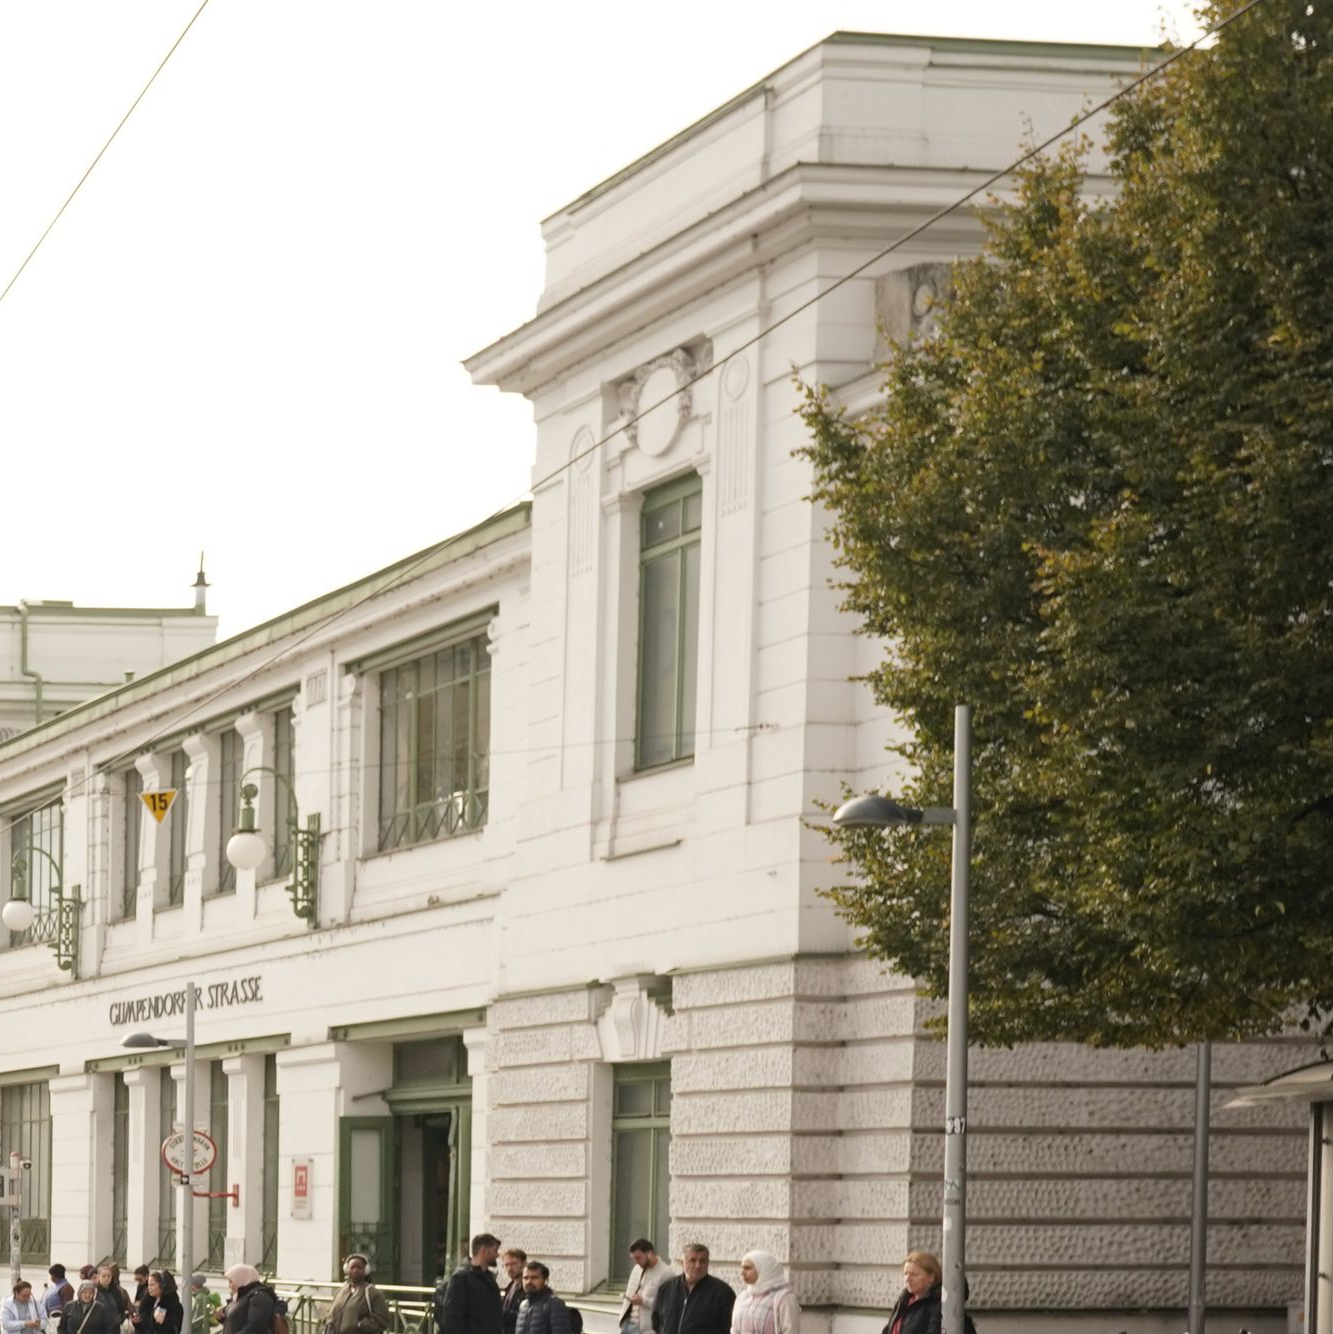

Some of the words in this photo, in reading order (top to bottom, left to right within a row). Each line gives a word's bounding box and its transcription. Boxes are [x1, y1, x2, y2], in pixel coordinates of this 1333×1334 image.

[150, 792, 168, 811] 15
[109, 987, 204, 1026] GUMPENDORFR
[207, 976, 263, 1009] STRASSE
